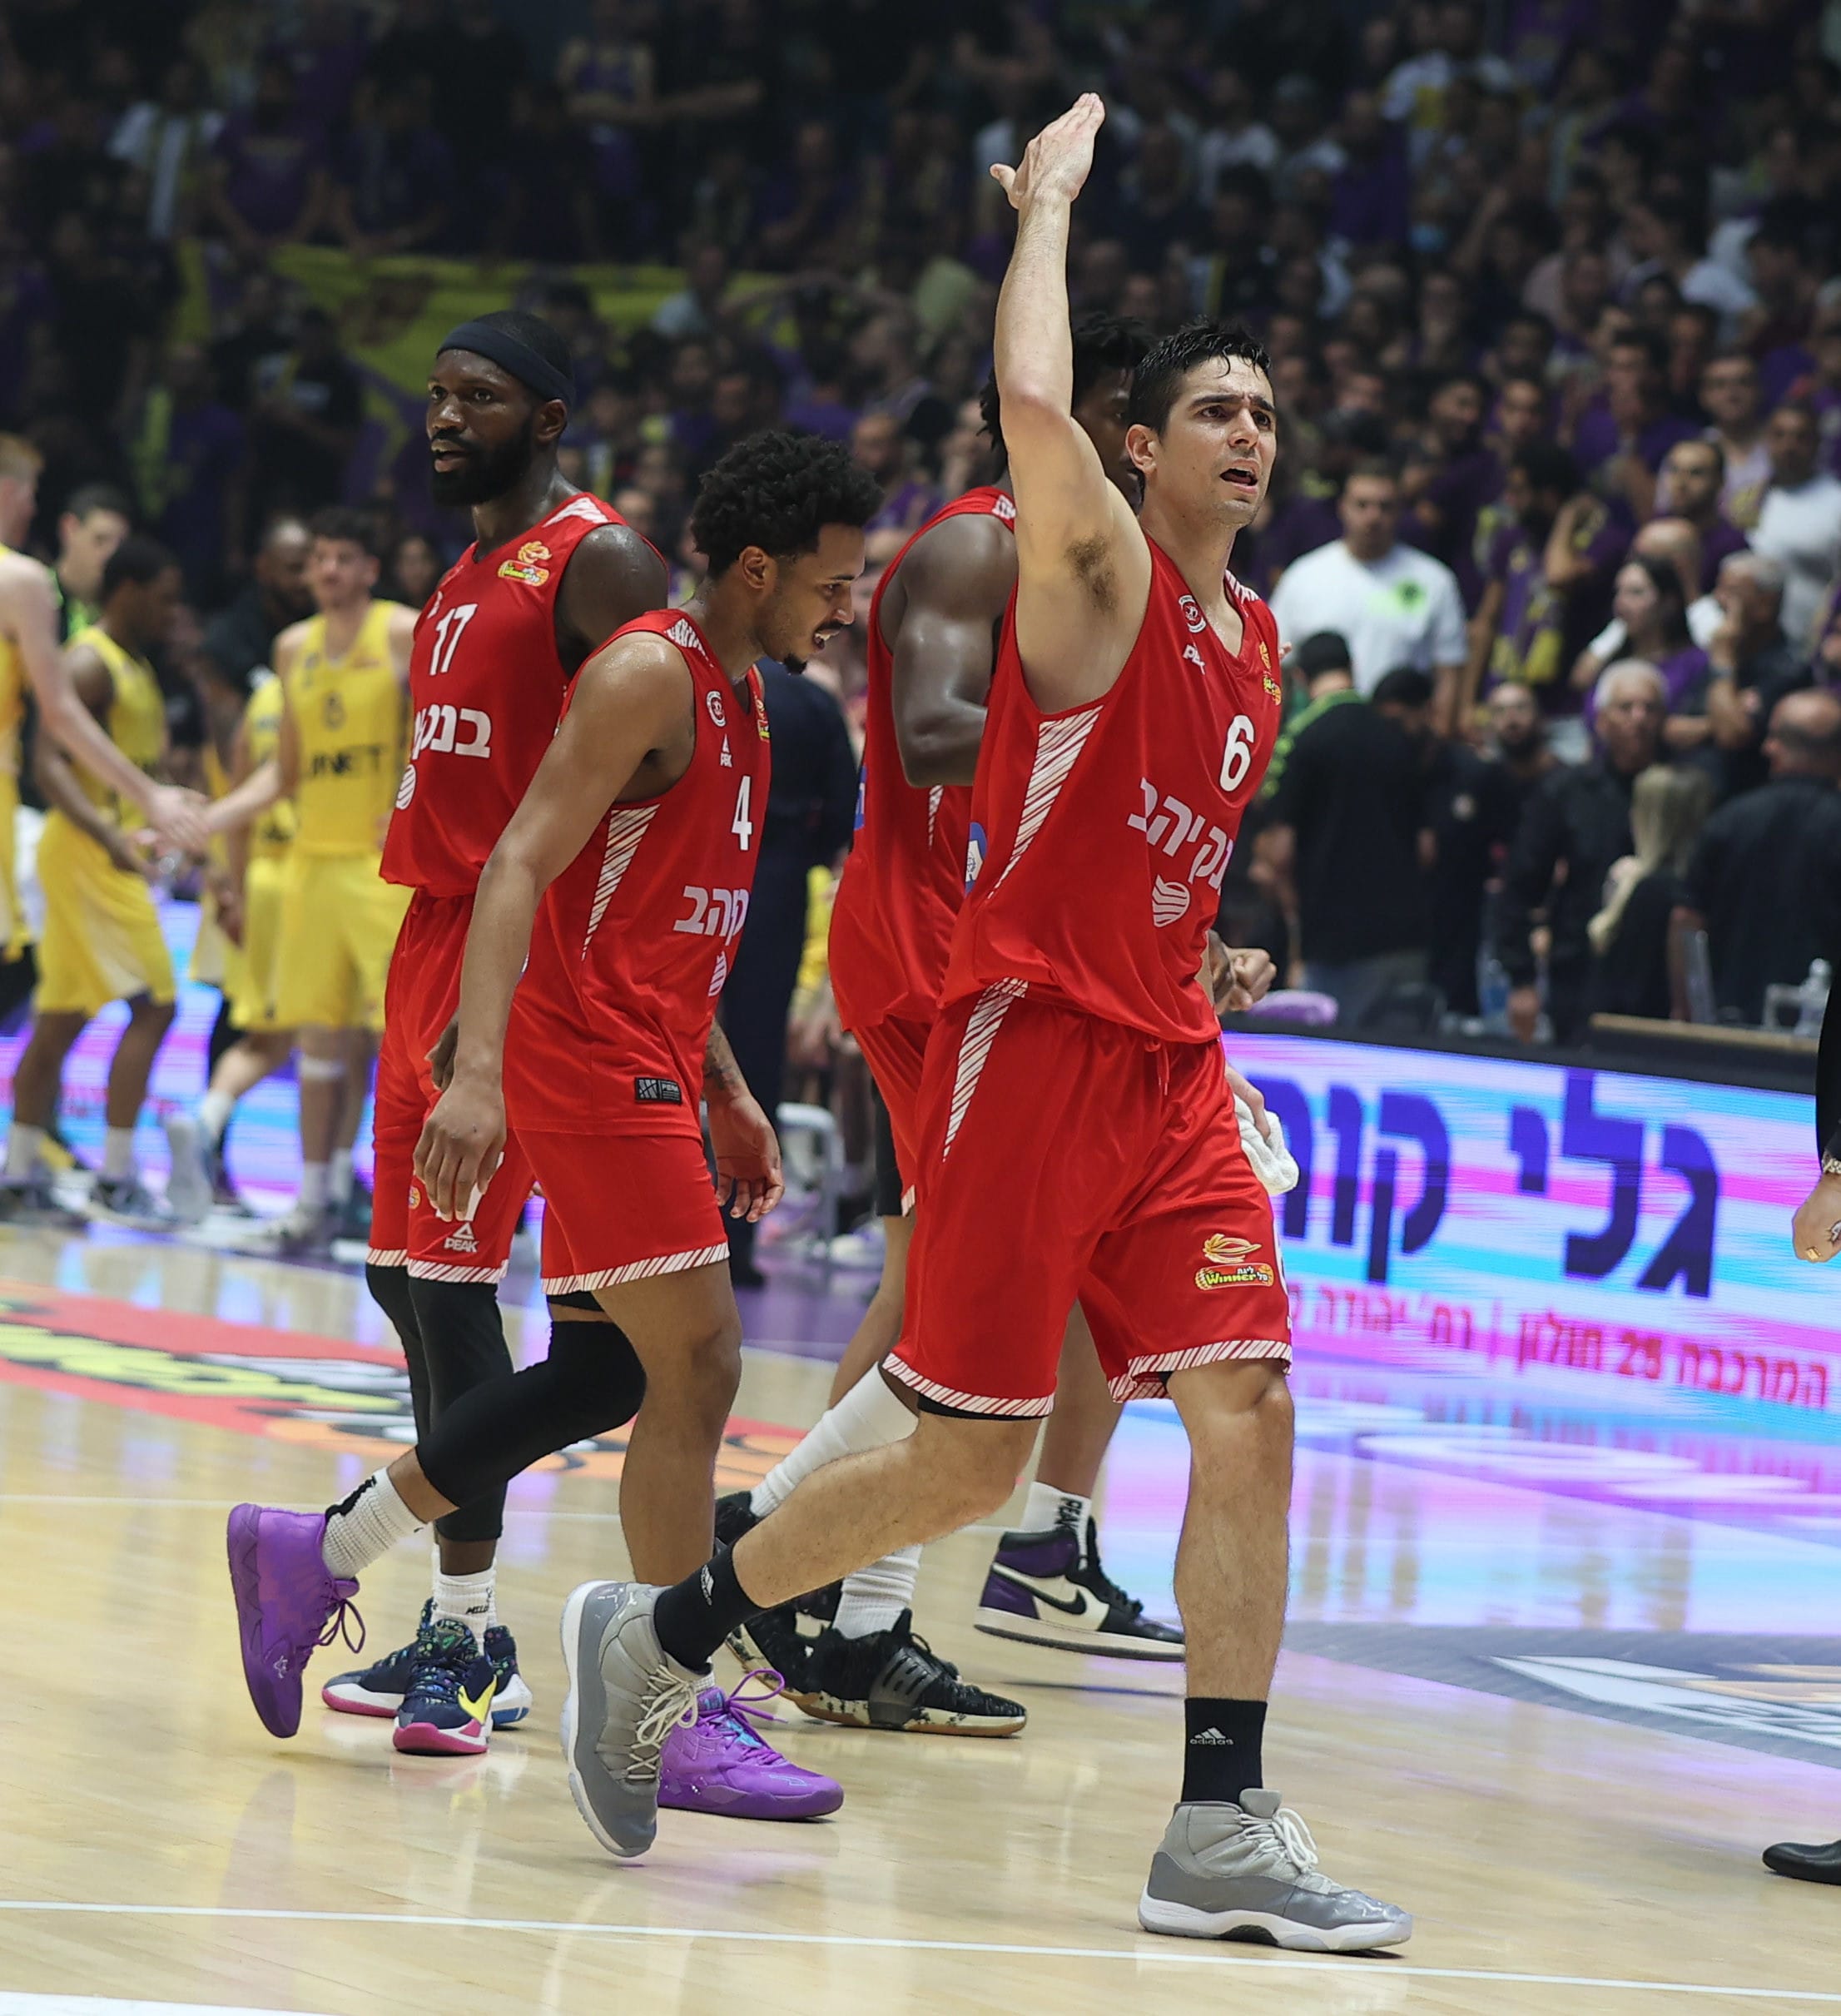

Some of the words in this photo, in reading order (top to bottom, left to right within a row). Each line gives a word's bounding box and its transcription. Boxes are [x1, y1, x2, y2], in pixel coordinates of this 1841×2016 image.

[429, 603, 479, 676] 17
[1220, 715, 1255, 792] 6
[731, 775, 753, 852] 4
[1188, 826, 1234, 896] נק
[1509, 1067, 1720, 1298] גלי
[444, 1237, 480, 1253] PEAK
[1205, 1272, 1257, 1285] Winner
[1617, 1331, 1663, 1380] 25
[1189, 1737, 1235, 1746] adidas
